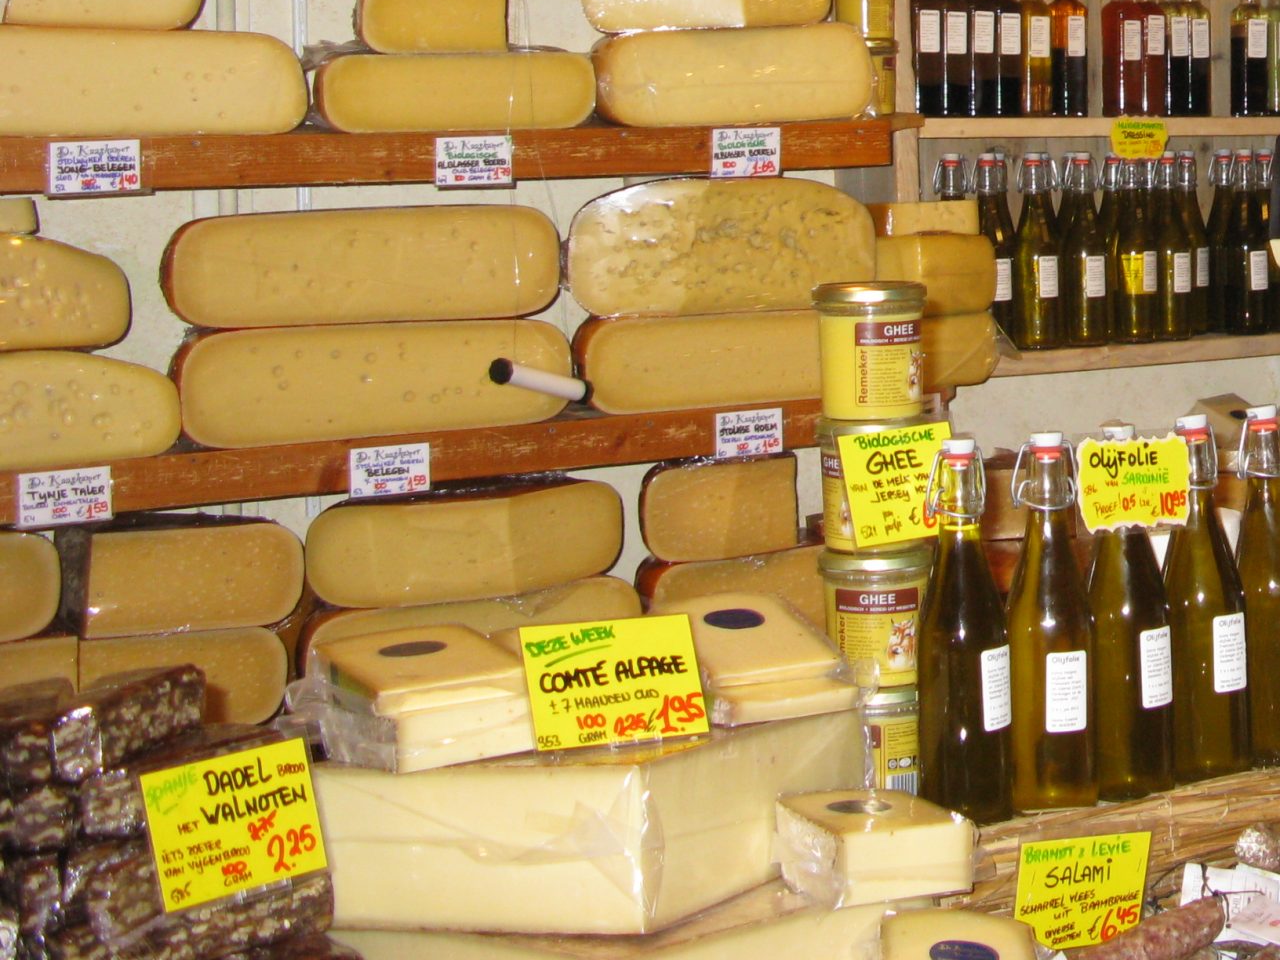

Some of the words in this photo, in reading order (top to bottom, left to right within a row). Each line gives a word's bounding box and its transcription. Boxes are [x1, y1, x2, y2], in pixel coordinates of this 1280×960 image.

[884, 323, 914, 336] GHEE
[858, 348, 868, 404] Remeker
[866, 449, 923, 475] GHEE
[71, 484, 106, 496] TALER
[859, 593, 896, 605] GHEE
[525, 636, 570, 658] DEZE
[540, 660, 609, 693] COMTÉ
[615, 655, 688, 683] ALPAGE
[576, 713, 607, 731] 100
[203, 756, 273, 796] DADEL
[200, 783, 307, 826] WALNOTEN
[1024, 845, 1076, 864] BRANDT
[1044, 858, 1112, 888] SALAMI
